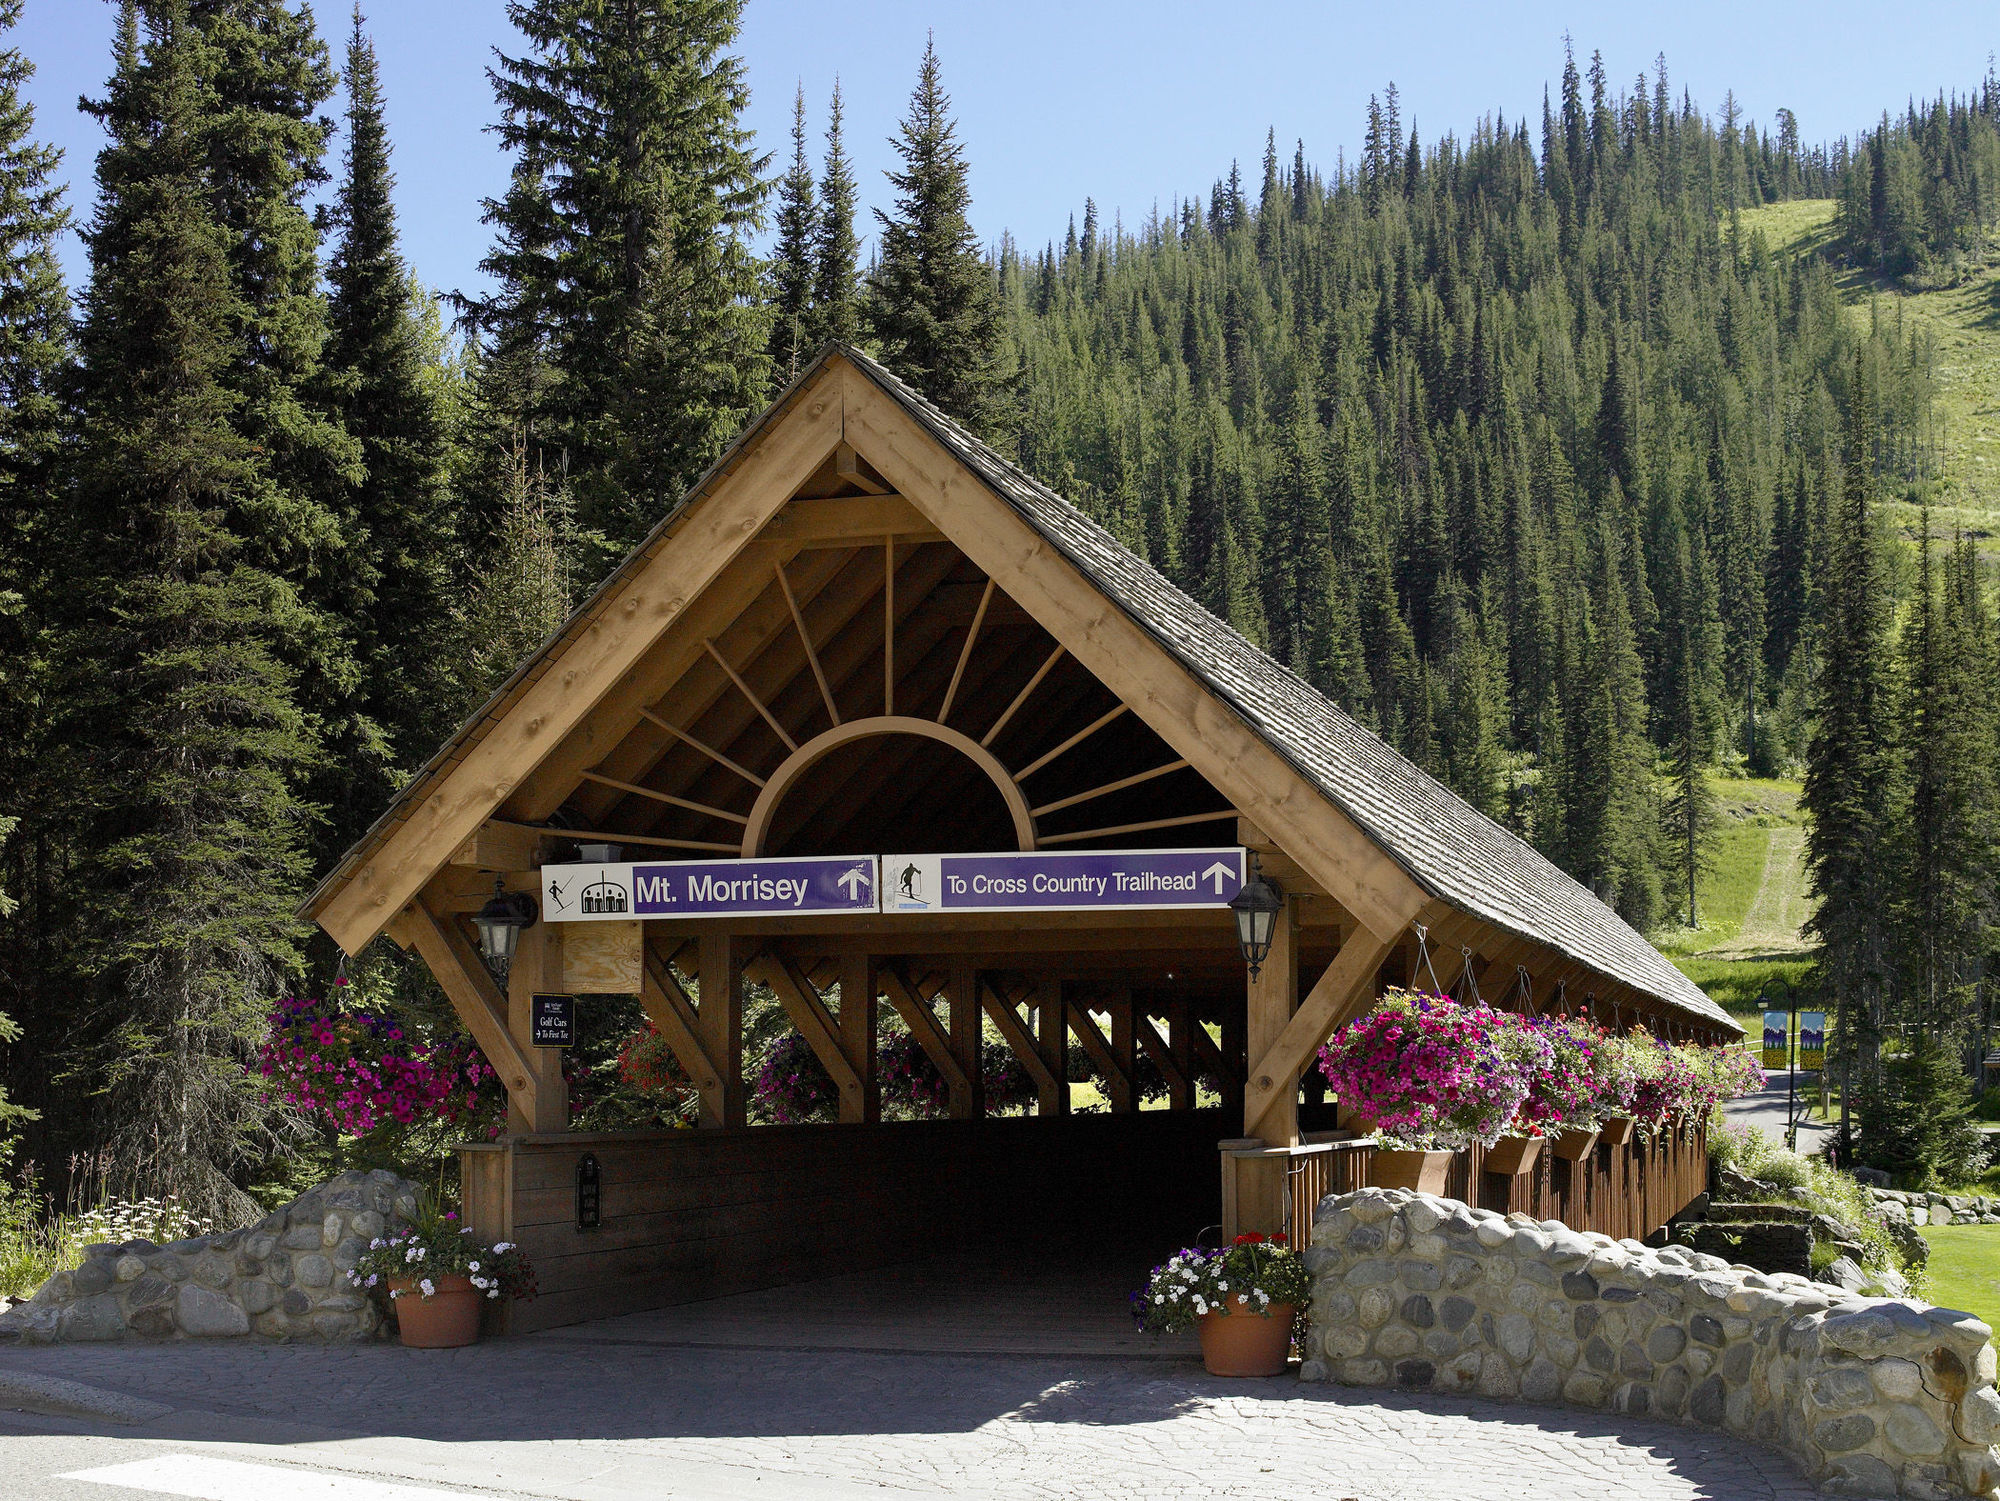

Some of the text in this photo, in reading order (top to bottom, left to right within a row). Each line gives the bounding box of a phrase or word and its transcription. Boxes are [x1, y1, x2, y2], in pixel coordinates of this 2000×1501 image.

[637, 874, 808, 906] Mt. Morrisey
[947, 871, 1196, 897] To Cross Country Trailhead
[540, 1016, 553, 1026] Golf
[542, 1030, 548, 1038] To
